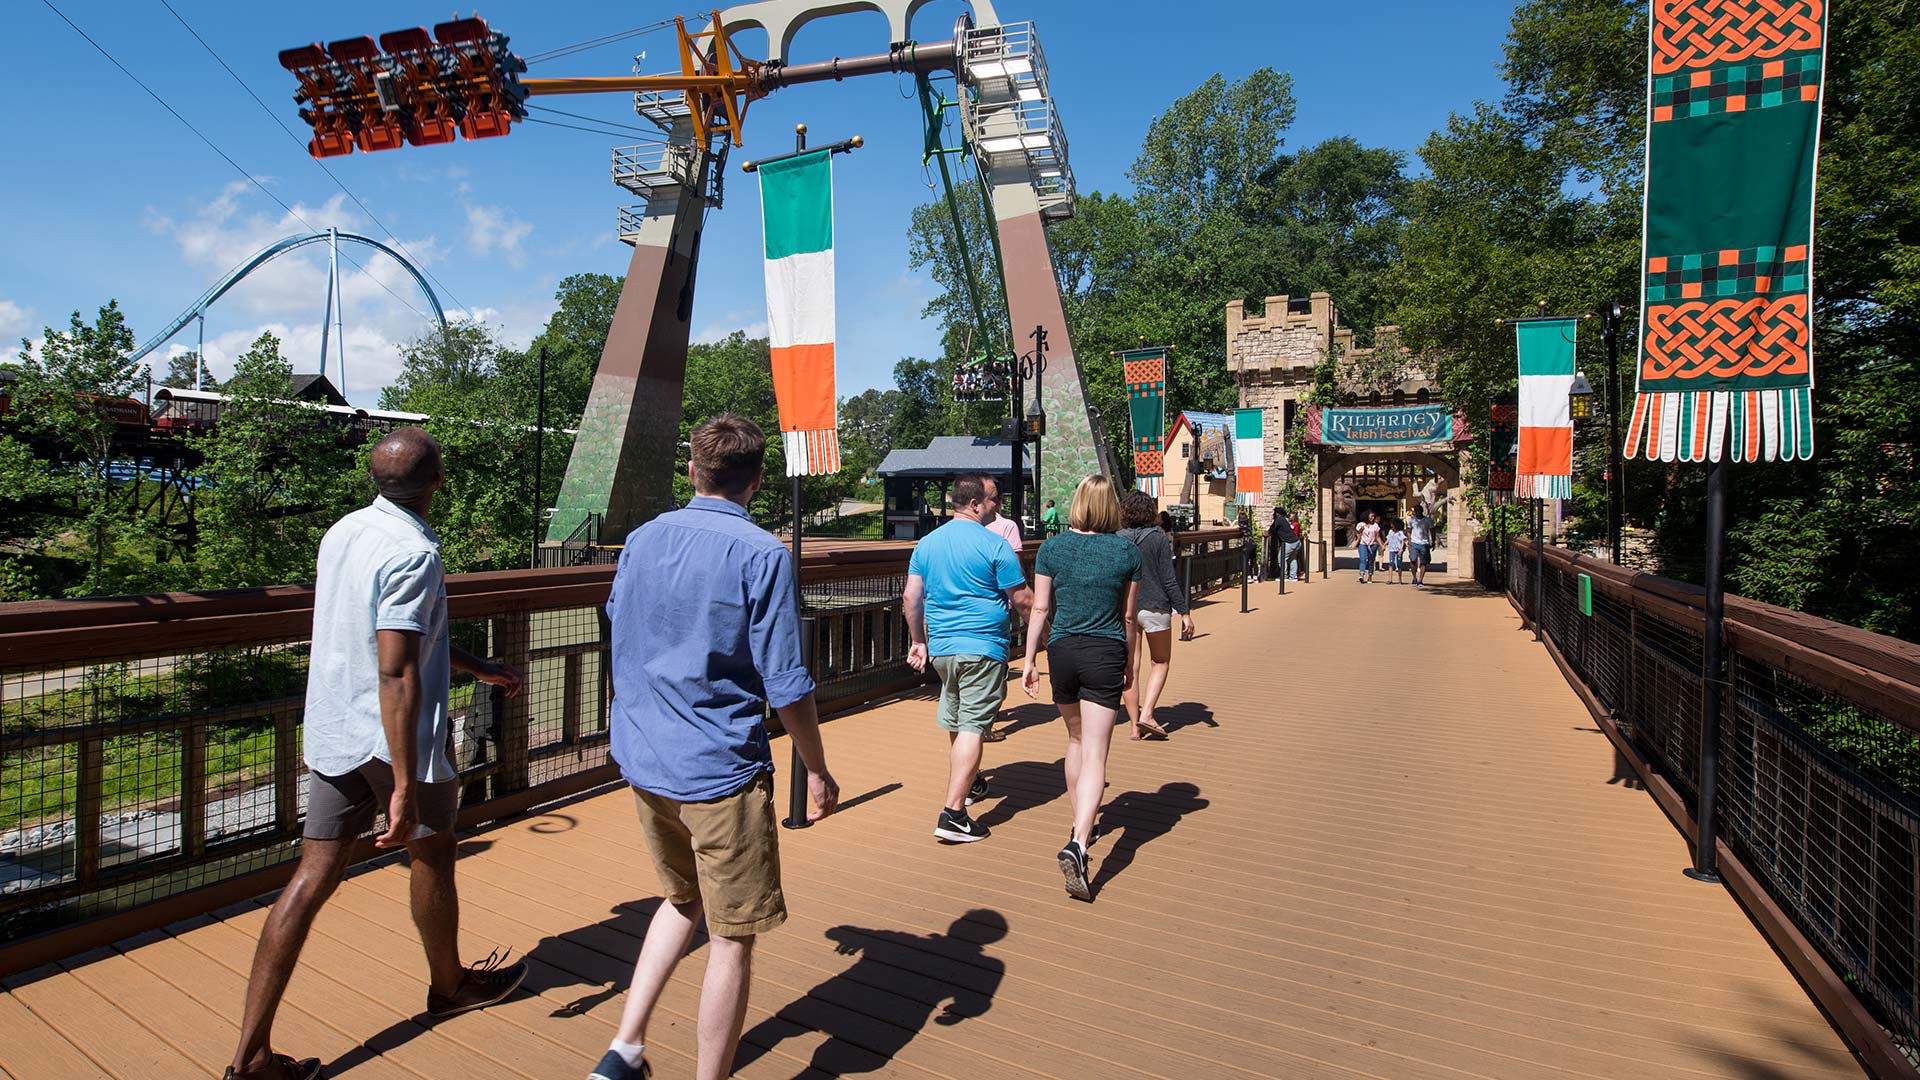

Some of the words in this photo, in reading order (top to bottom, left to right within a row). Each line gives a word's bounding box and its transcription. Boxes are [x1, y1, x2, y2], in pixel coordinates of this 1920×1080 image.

[1331, 412, 1440, 432] KILLARNEY
[1346, 427, 1377, 439] Irish
[1379, 426, 1432, 439] Festival
